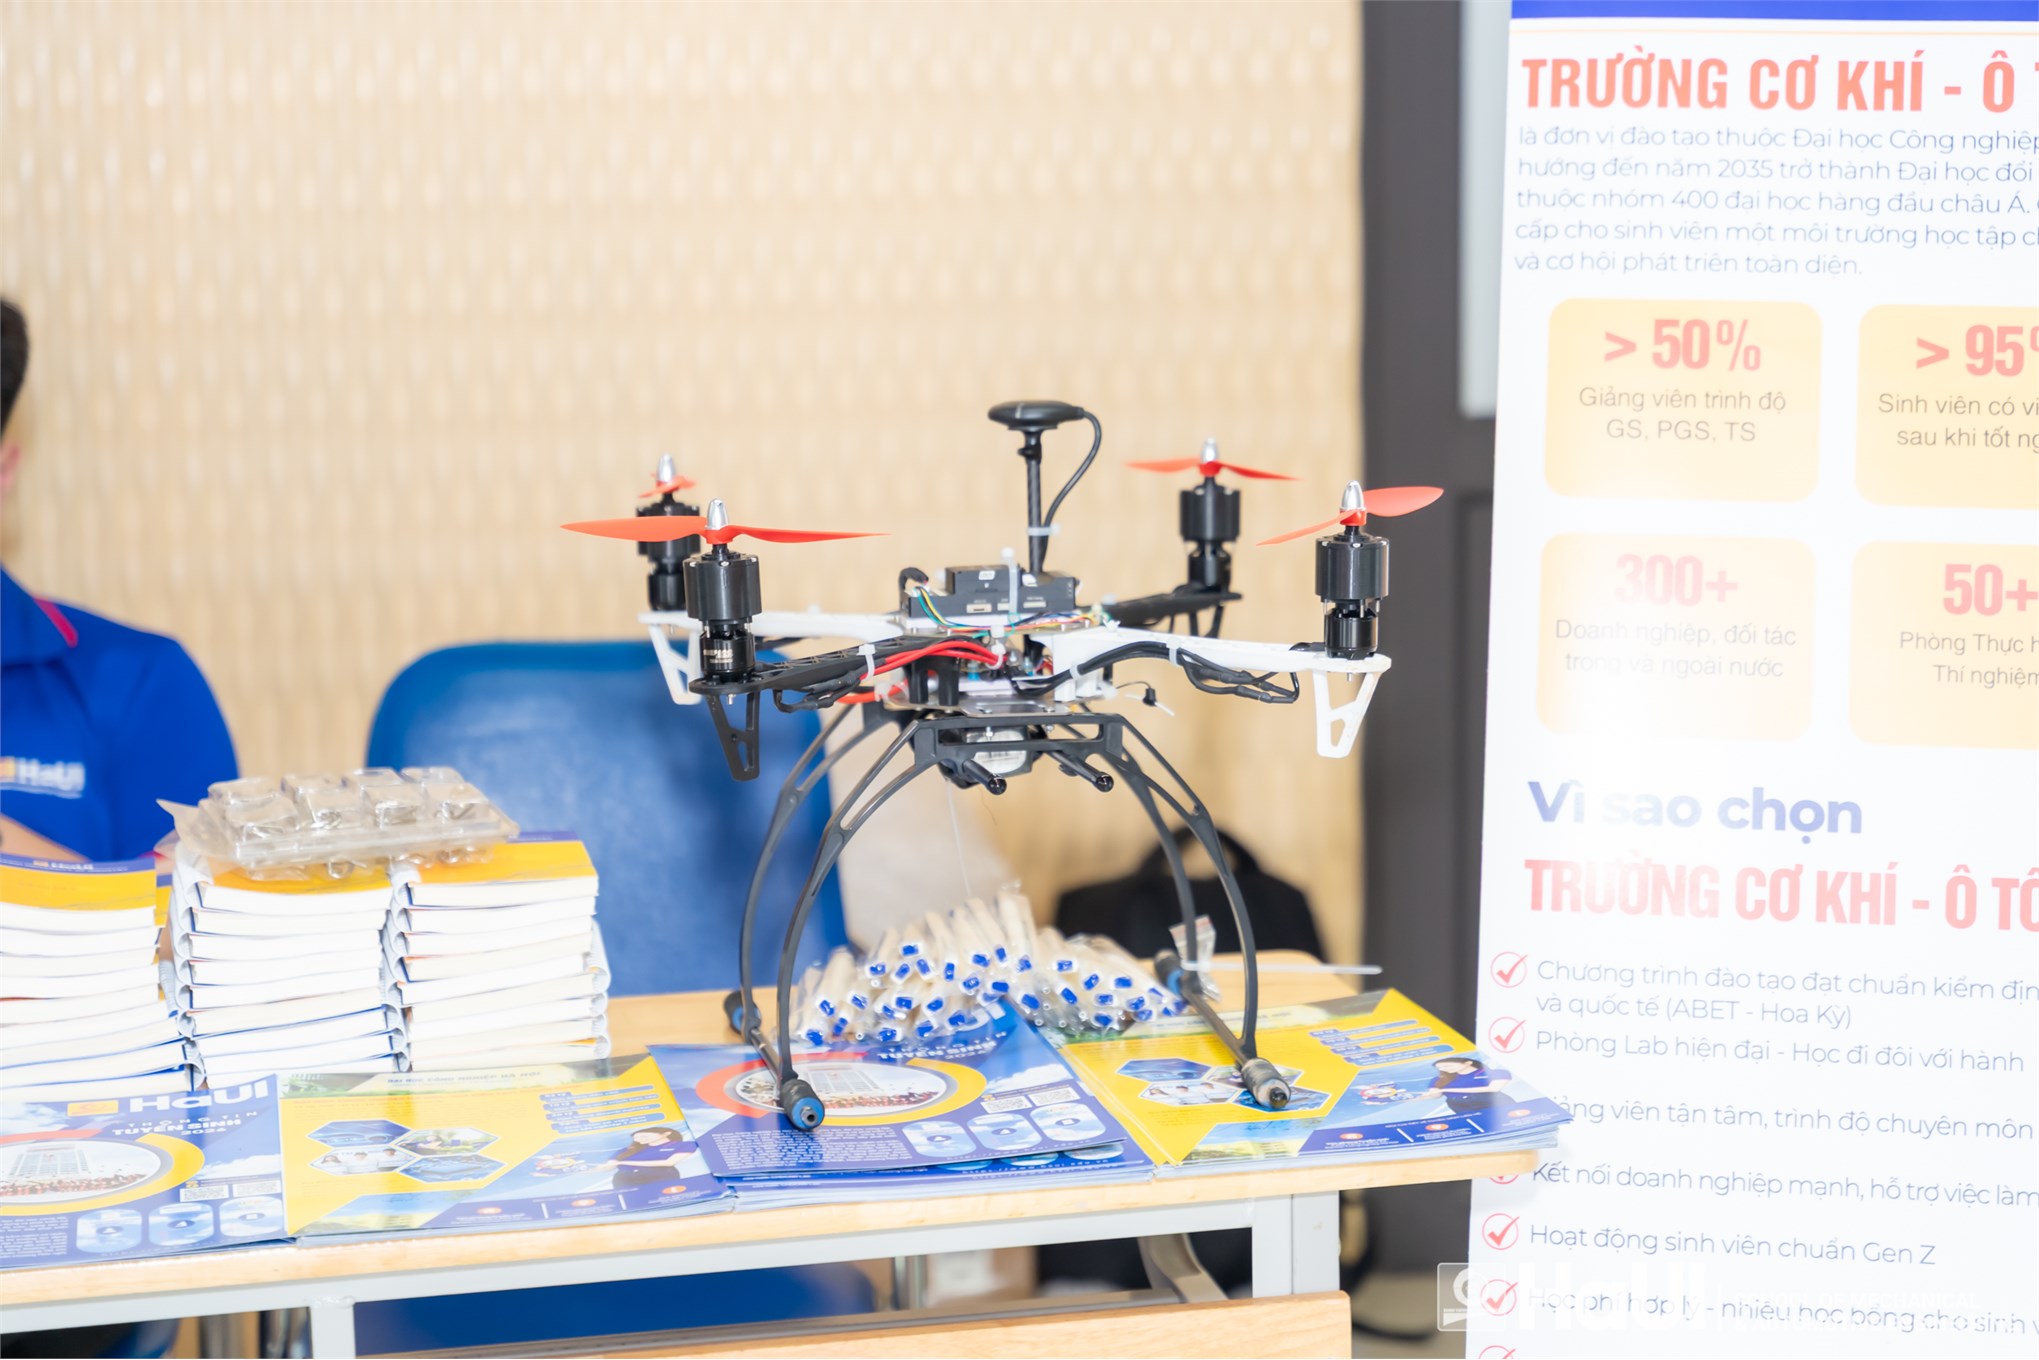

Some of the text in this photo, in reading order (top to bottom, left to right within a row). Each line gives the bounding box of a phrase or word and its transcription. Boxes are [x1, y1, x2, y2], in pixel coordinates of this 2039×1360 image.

[1520, 44, 2016, 114] TRƯỜNG CƠ KHÍ Ô
[1519, 124, 1537, 147] là
[1543, 124, 1590, 147] đơn
[1620, 124, 1666, 148] đào
[1672, 126, 1711, 151] tạo
[1716, 126, 1786, 152] thuộc
[1792, 127, 1832, 152] Đại
[1839, 128, 1883, 153] học
[1889, 128, 1955, 156] Công
[1518, 156, 1596, 182] hướng
[1602, 156, 1649, 178] đến
[1656, 157, 1711, 178] năm
[1717, 158, 1774, 179] 2035
[1779, 156, 1813, 181] trở
[1818, 159, 1890, 182] thành
[1897, 160, 1937, 187] Đại
[1945, 160, 1989, 187] học
[1516, 187, 1585, 213] thuộc
[1592, 188, 1665, 210] nhóm
[1671, 189, 1719, 210] 400
[1724, 189, 1760, 215] đại
[1767, 190, 1811, 216] học
[1818, 191, 1881, 217] hàng
[1940, 192, 2001, 215] châu
[2007, 189, 2030, 215] Á.
[1515, 216, 2017, 251] cấp cho sinh viên một môi trường học tập
[1514, 249, 1540, 272] và
[1545, 252, 1575, 272] cơ
[1580, 250, 1616, 277] hội
[1622, 251, 1677, 275] phát
[1745, 253, 1799, 275] toàn
[1651, 317, 1763, 373] 50%
[1578, 384, 1787, 415] Giảng viên trình độ
[1877, 391, 2016, 417] Sinh viên có
[1606, 417, 1756, 445] GS, PGS, TS
[1896, 429, 1937, 448] sau
[1944, 427, 1976, 448] khi
[1983, 425, 2011, 450] tốt
[1614, 552, 1739, 607] 300+
[1942, 562, 2039, 617] 50+
[1900, 630, 2025, 657] Phòng Thực
[1932, 664, 1966, 685] Thí
[1600, 792, 1703, 829] sao
[1716, 785, 1864, 846] chọn
[1523, 847, 1720, 920] TRƯỜNG
[1733, 862, 1805, 923] CƠ
[1814, 861, 1899, 927] KHÍ
[1944, 862, 1979, 931] Ô
[1537, 959, 1635, 989] Chương
[1641, 963, 1698, 987] trình
[1704, 966, 1751, 990] đào
[1756, 969, 1796, 995] tạo
[1801, 970, 1843, 998] đạt
[1848, 971, 1926, 998] chuẩn
[1933, 974, 1995, 1000] kiểm
[1535, 991, 1562, 1013] và
[1568, 991, 1630, 1018] quốc
[1635, 993, 1660, 1017] tế
[1666, 996, 1741, 1022] (ABET
[1761, 1000, 1809, 1025] Hoa
[1536, 1029, 2024, 1073] Phòng Lab hiện đại Học đi đôi với hành
[130, 1080, 268, 1112] HaUI
[1553, 1095, 1604, 1124] ảng
[1610, 1099, 1660, 1122] viên
[1666, 1100, 1707, 1128] tận
[1712, 1103, 1768, 1130] tâm,
[1773, 1106, 1831, 1131] trình
[1838, 1109, 1871, 1137] độ
[1876, 1111, 1968, 1141] chuyên
[1975, 1117, 2033, 1141] môn
[1532, 1160, 2039, 1209] Kết nối doanh nghiệp mạnh, hỗ trợ việc làm
[1530, 1223, 1936, 1266] Hoạt động sinh viên chuẩn Gen Z
